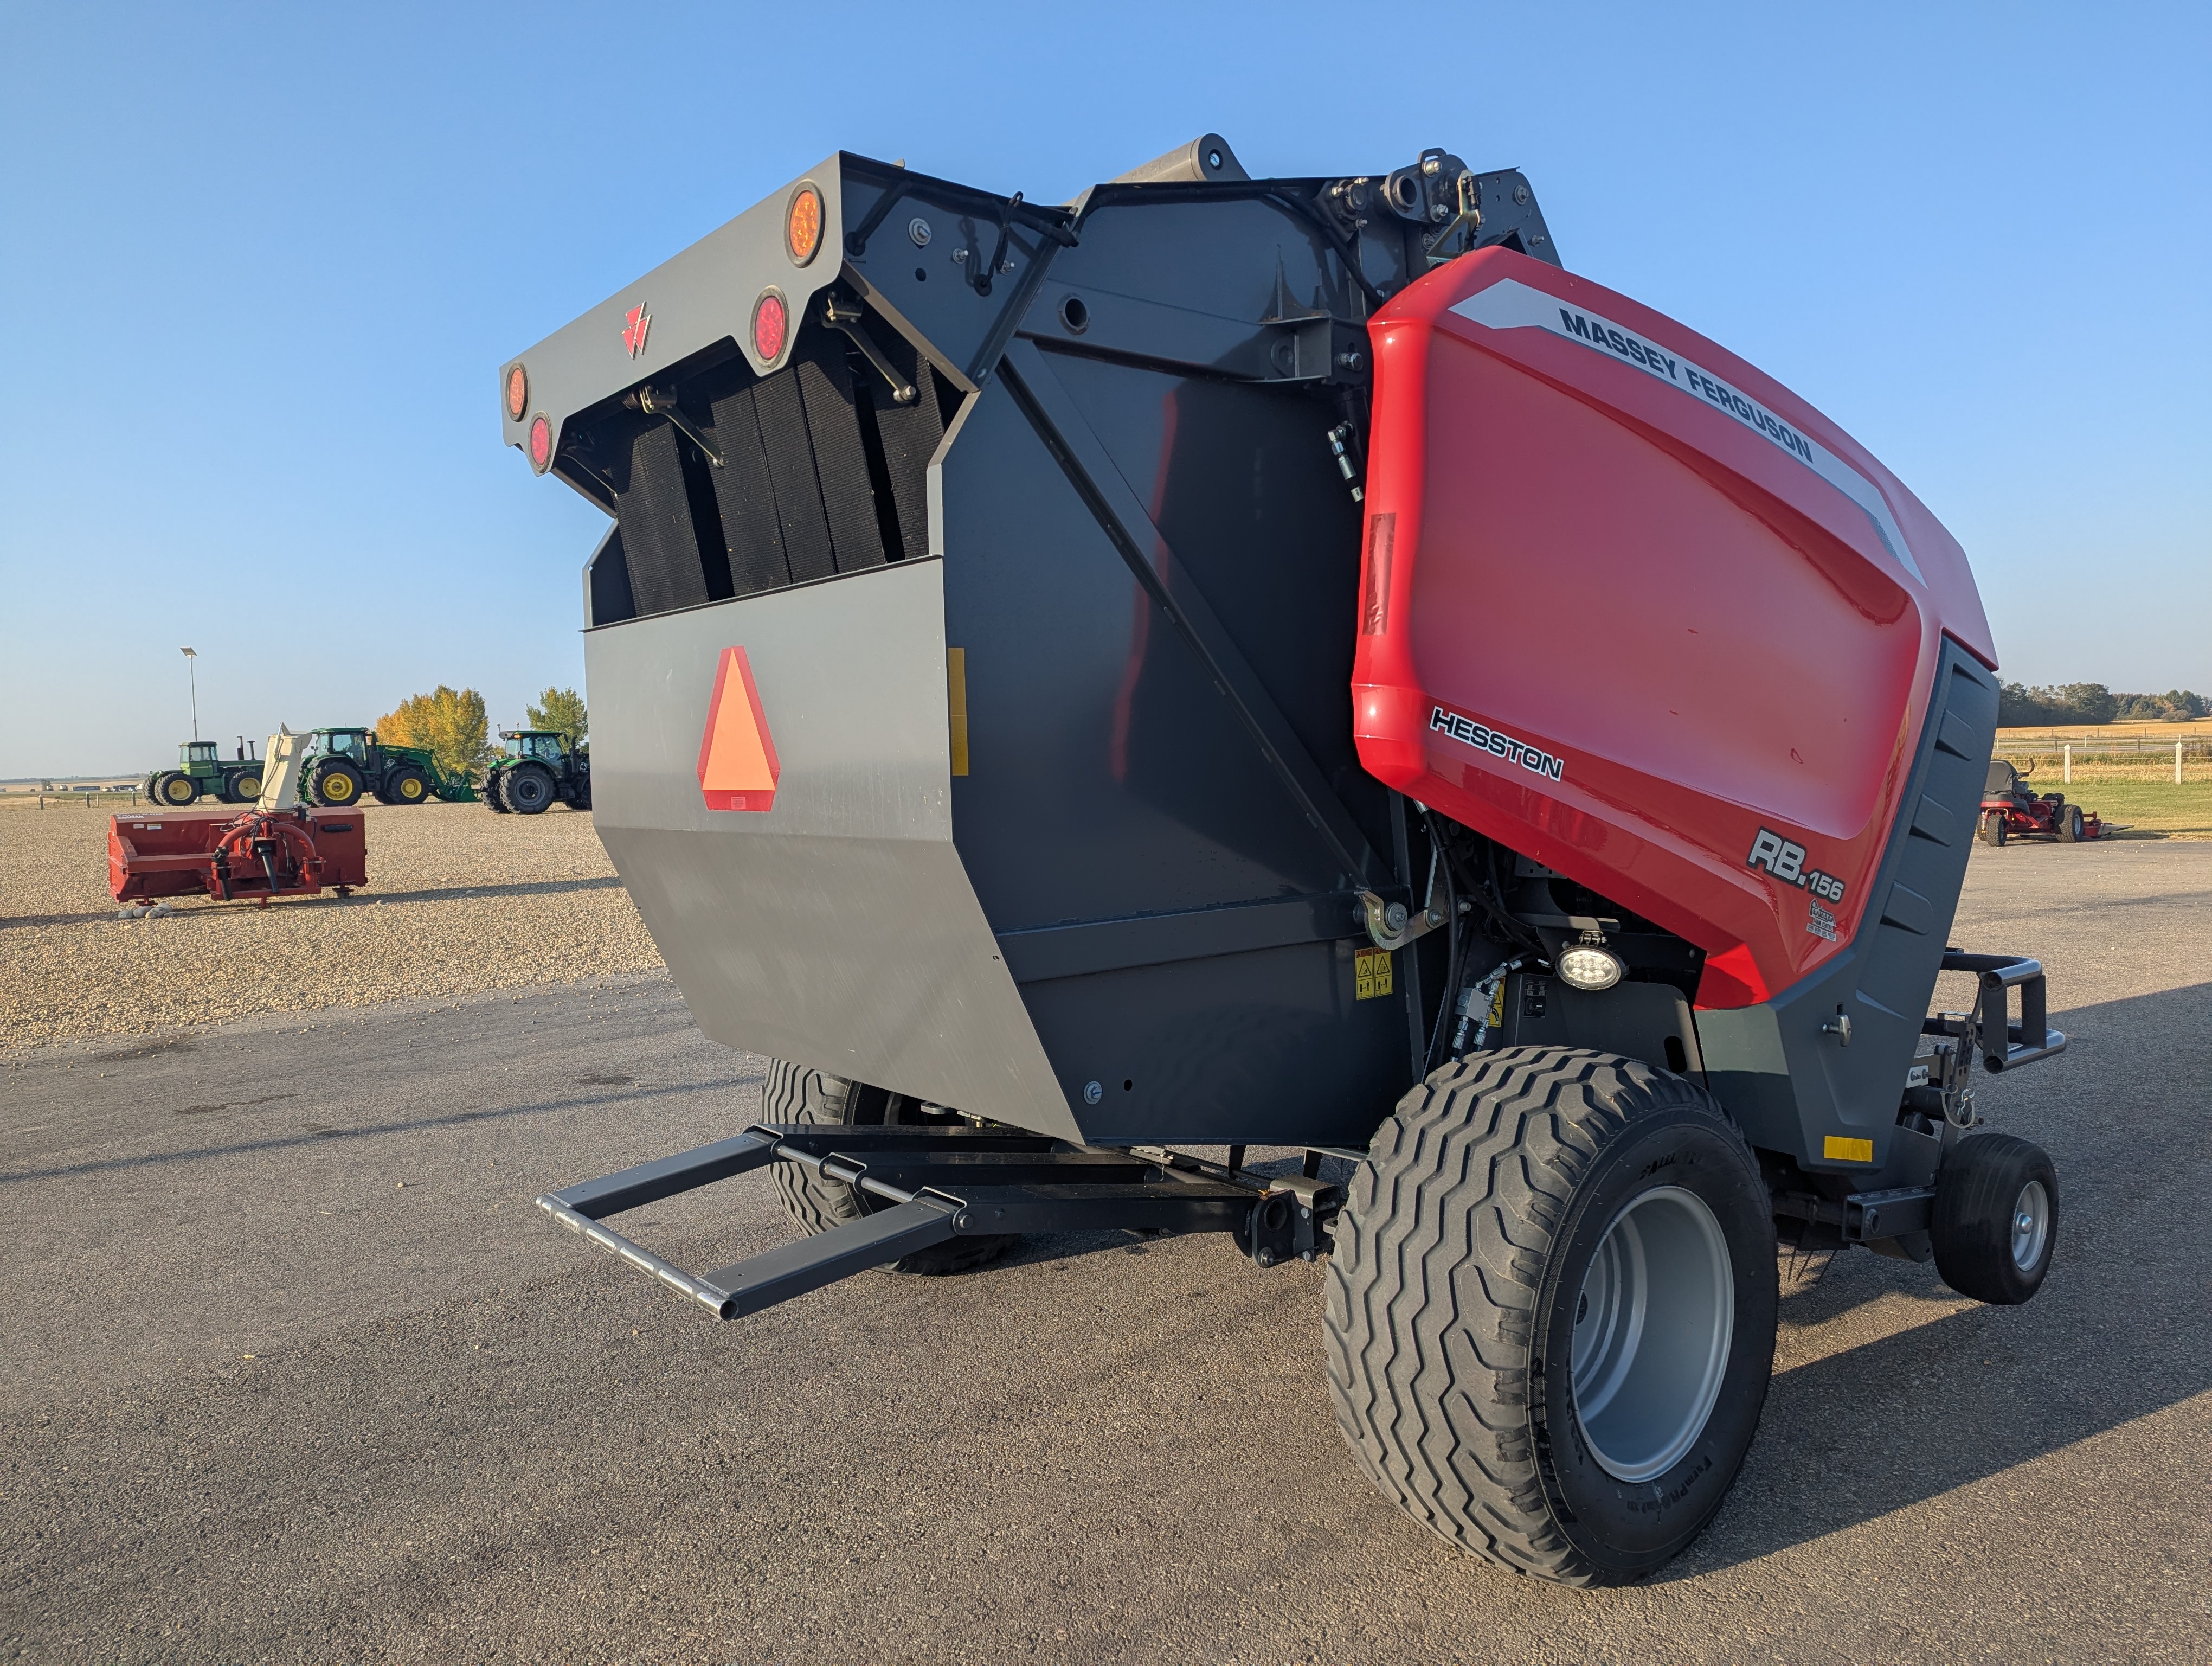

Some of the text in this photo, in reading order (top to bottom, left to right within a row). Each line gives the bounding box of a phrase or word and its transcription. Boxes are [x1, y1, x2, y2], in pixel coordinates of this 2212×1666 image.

[1559, 307, 1813, 464] MASSEY FERGUSON
[1430, 706, 1565, 781] HESSTON
